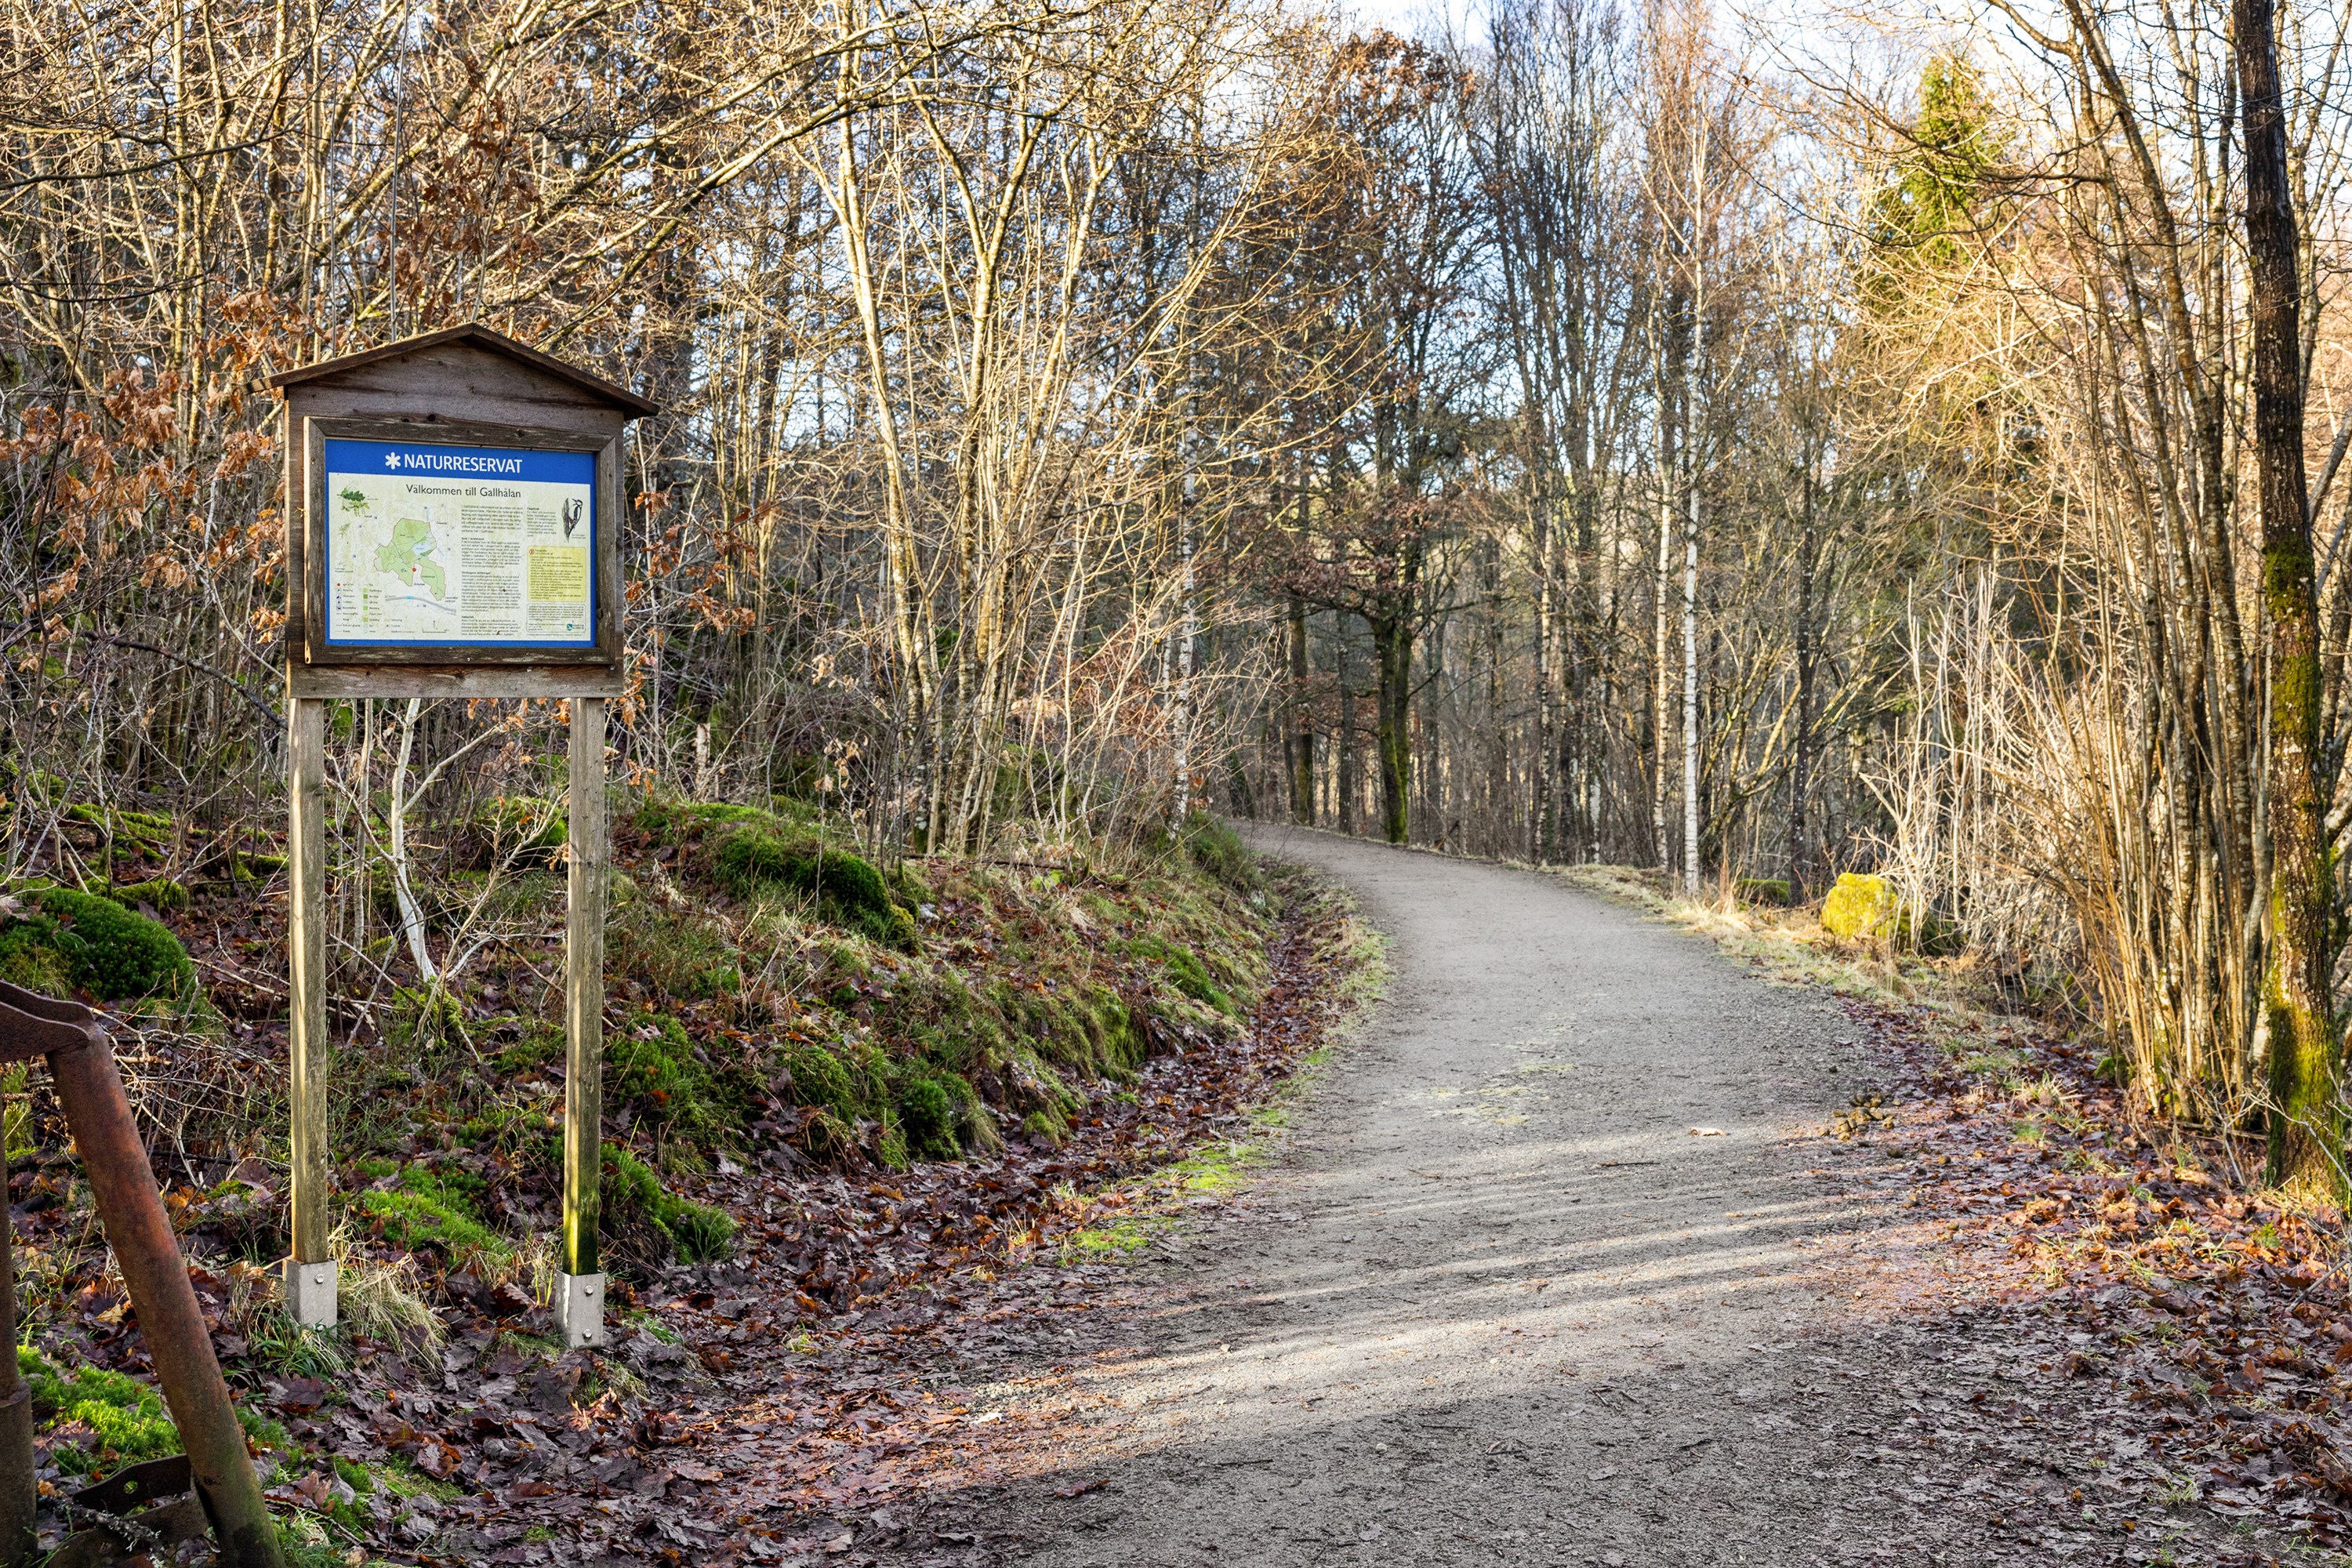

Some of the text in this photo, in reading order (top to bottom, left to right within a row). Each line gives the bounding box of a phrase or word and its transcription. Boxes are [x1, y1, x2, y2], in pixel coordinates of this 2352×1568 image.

[404, 453, 523, 474] NATURRESERVAT
[406, 484, 521, 498] Välkommen till Gallhålan
